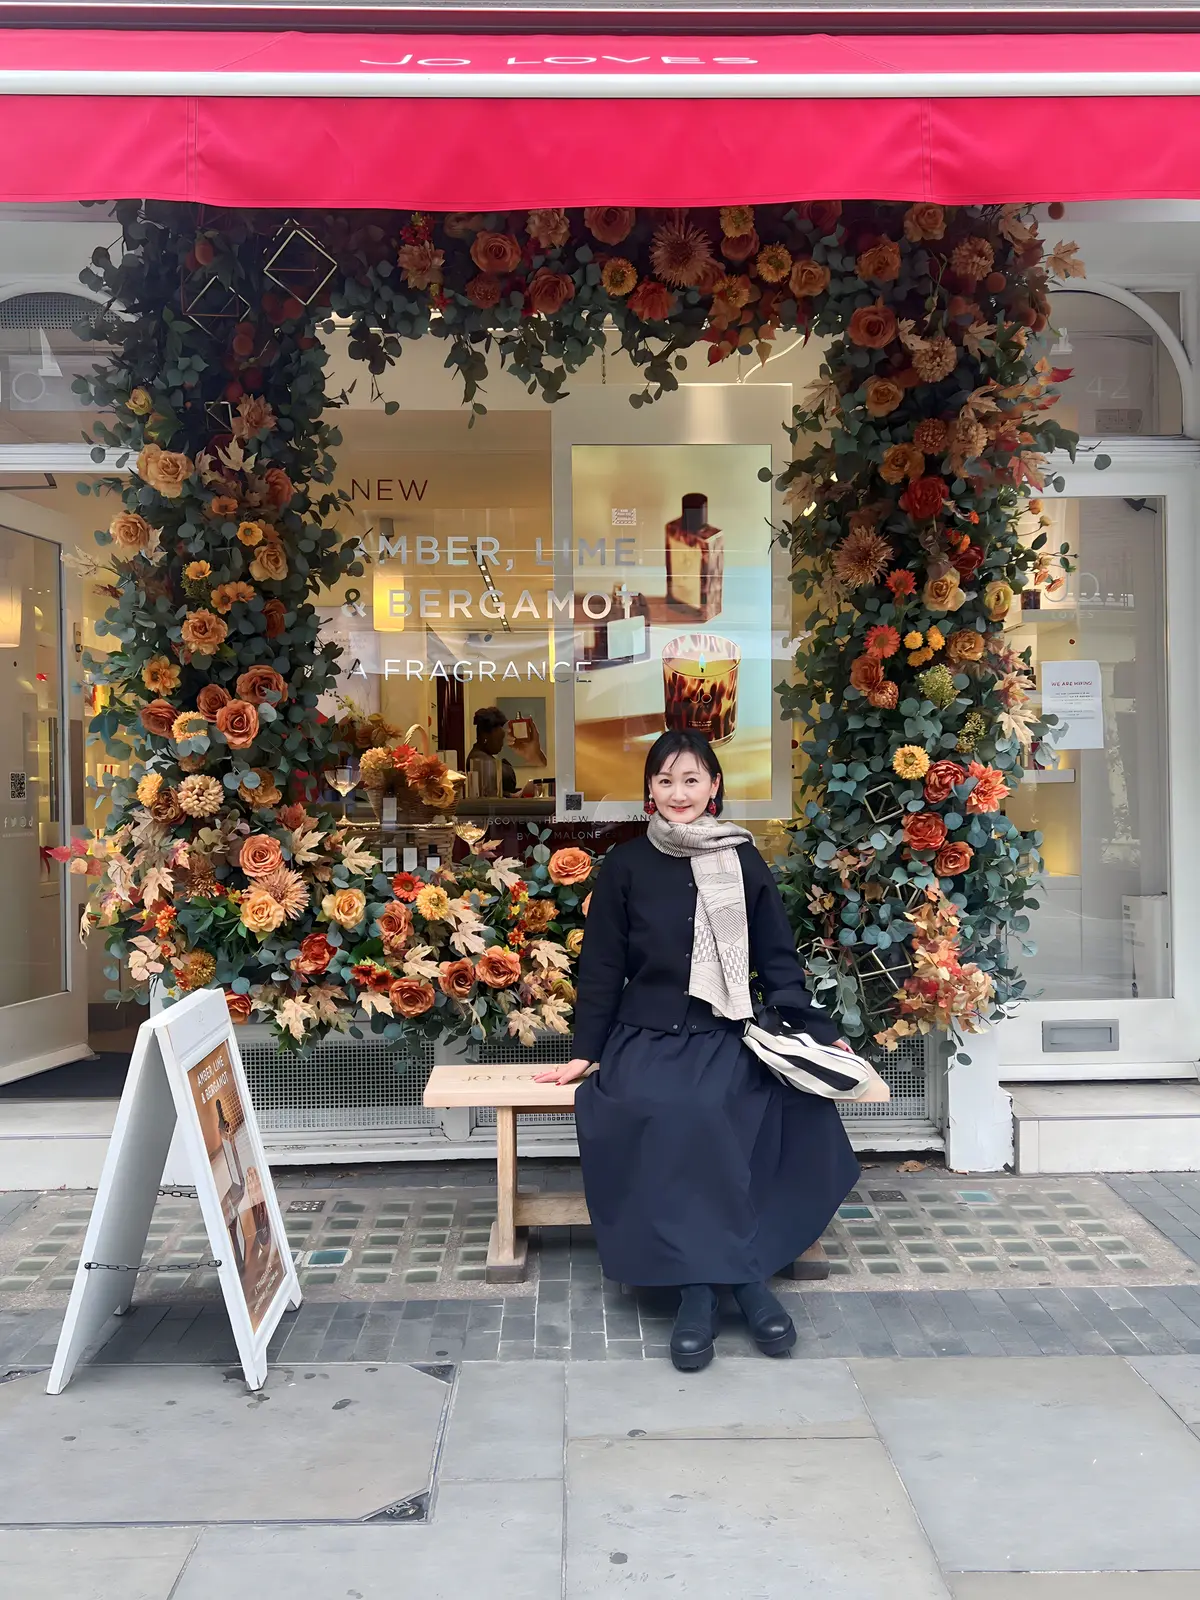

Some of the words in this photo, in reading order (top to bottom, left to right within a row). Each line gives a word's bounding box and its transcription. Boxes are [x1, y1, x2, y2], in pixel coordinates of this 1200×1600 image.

[359, 54, 472, 66] JO
[507, 56, 759, 65] LOVES
[350, 479, 428, 501] NEW
[535, 537, 636, 566] LIME
[341, 588, 367, 618] &
[388, 589, 640, 619] BERGAMOT
[347, 658, 367, 680] A
[385, 659, 592, 683] FRAGRANCE
[563, 815, 589, 823] NEW
[554, 830, 601, 840] MALONE
